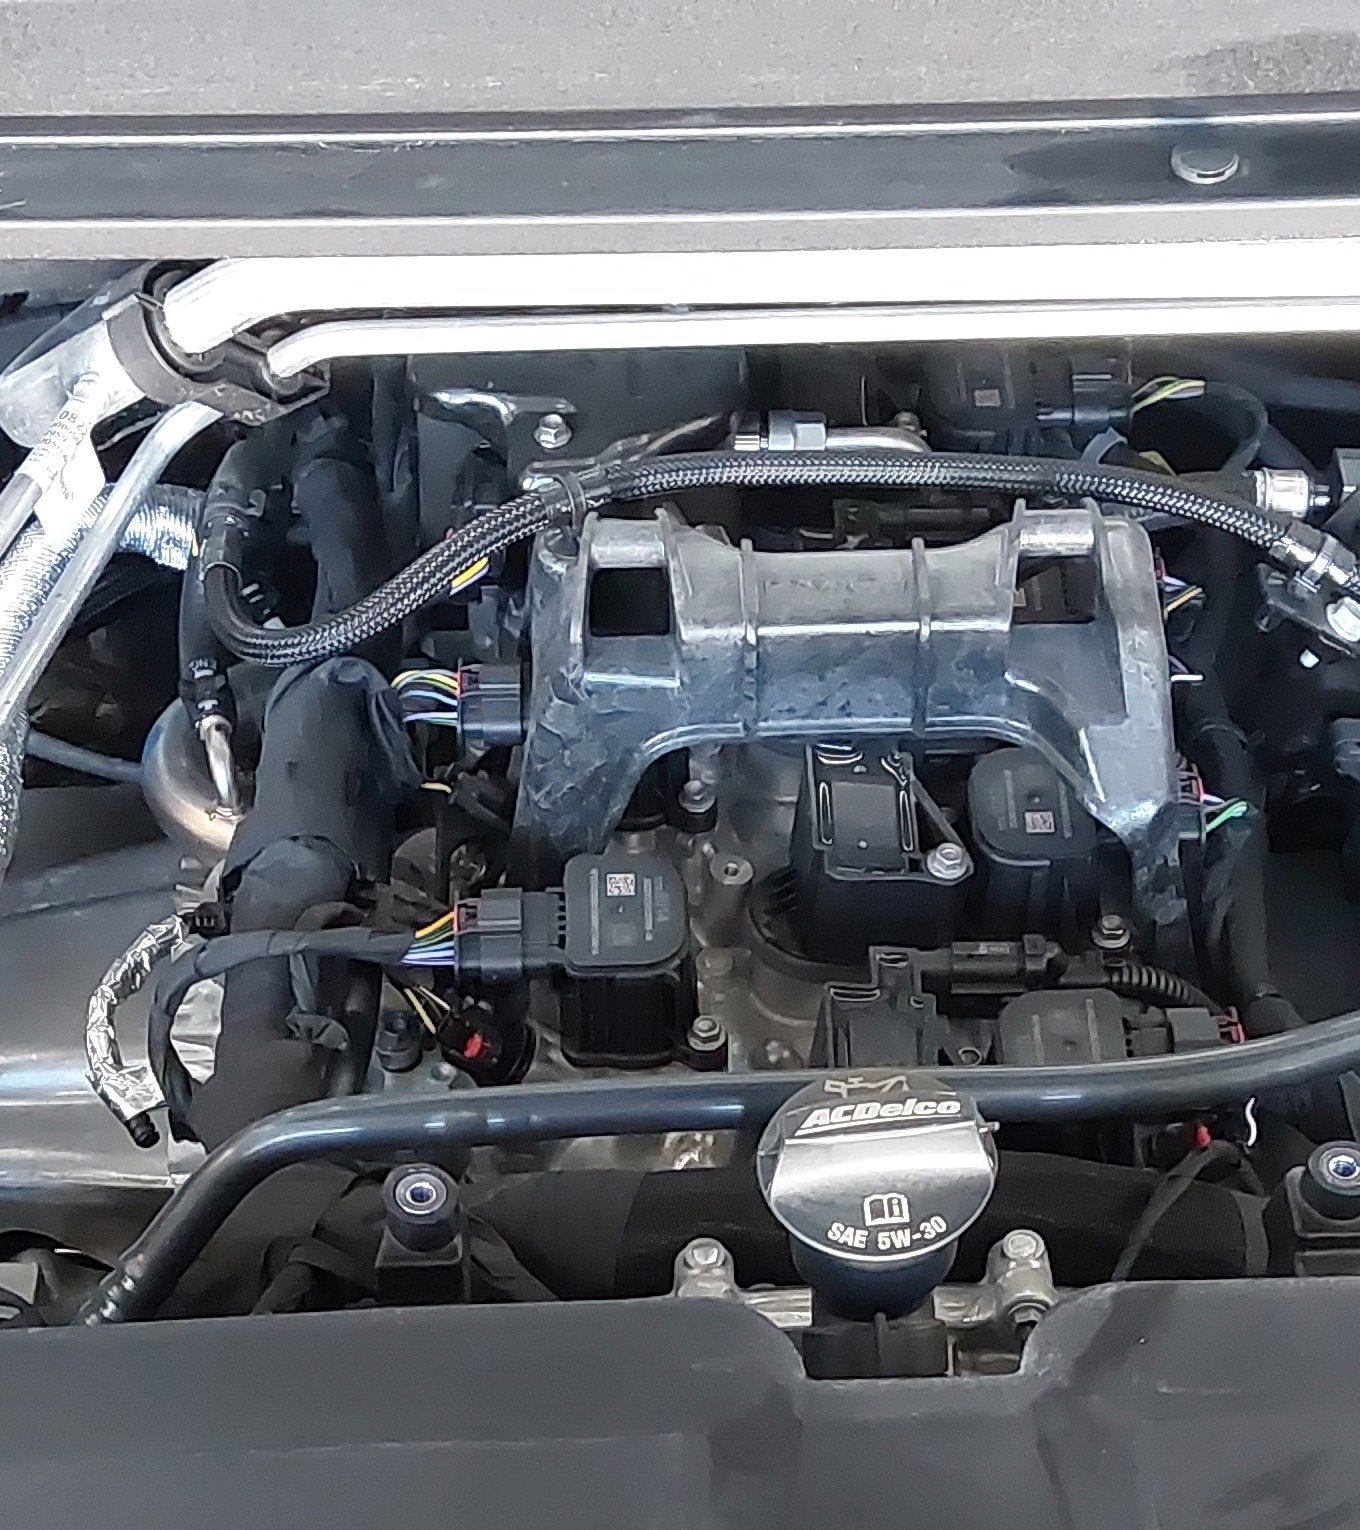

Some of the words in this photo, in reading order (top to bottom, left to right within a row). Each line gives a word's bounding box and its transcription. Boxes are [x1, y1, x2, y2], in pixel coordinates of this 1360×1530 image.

[801, 1098, 961, 1129] ACDelco
[827, 1222, 869, 1249] SAE
[877, 1215, 947, 1250] 5W-30
